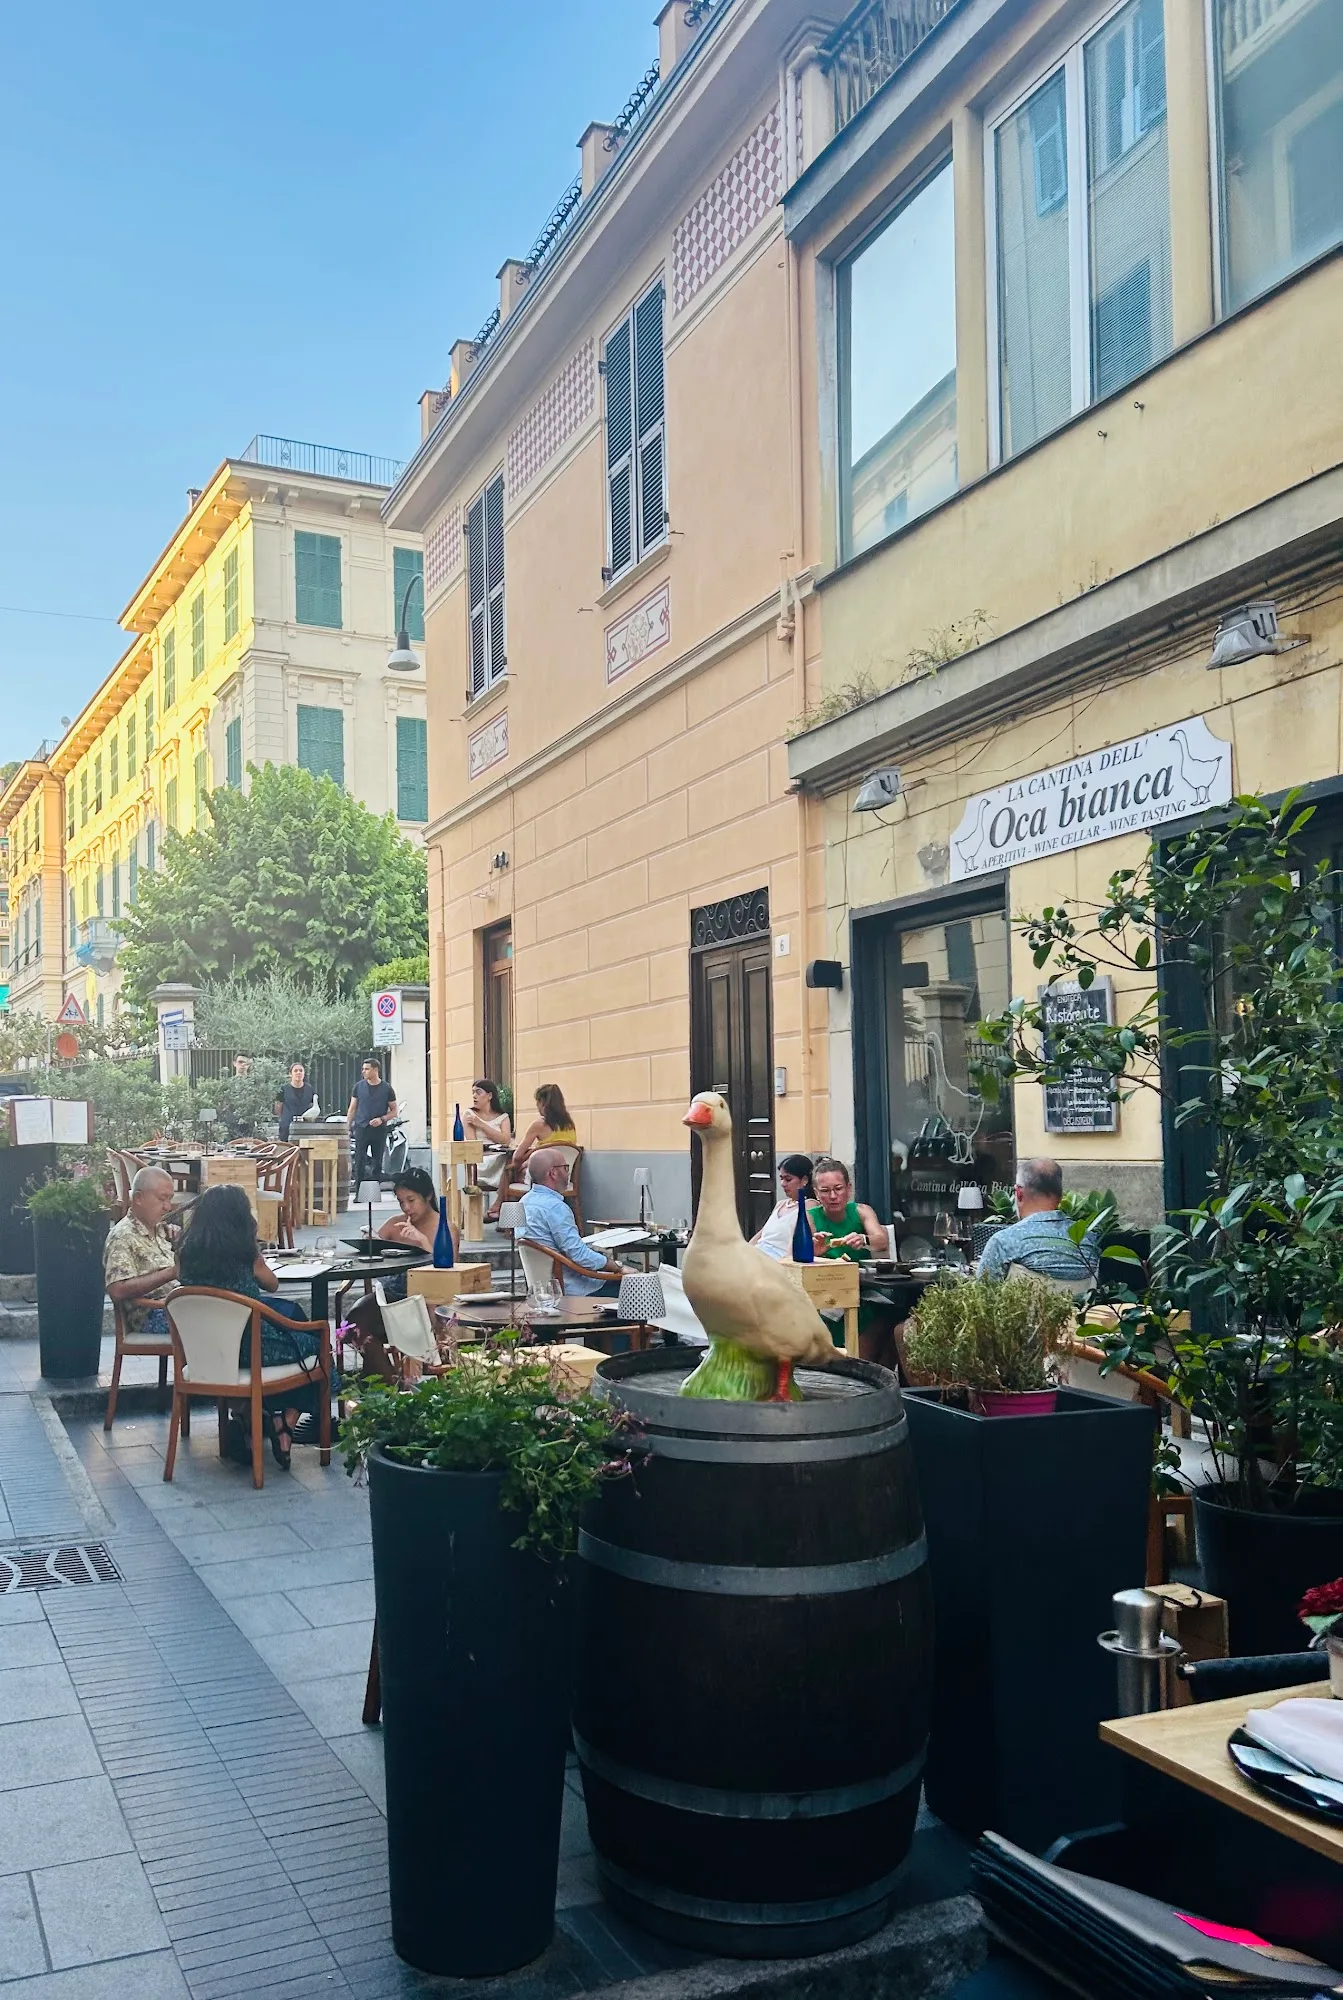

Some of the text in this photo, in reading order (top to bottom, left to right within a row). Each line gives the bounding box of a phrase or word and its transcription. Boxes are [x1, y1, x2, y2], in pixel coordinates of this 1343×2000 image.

[1007, 784, 1025, 803] LA
[1028, 759, 1093, 795] CANTINA
[989, 764, 1174, 849] Oca bianca
[980, 847, 1027, 869] APERITIVI
[1034, 837, 1059, 854] WINE
[1060, 824, 1100, 847] CELLAR
[1110, 816, 1138, 832] WINE
[1141, 799, 1187, 821] TASTING
[1057, 993, 1081, 1004] ENOTECA
[910, 1179, 946, 1193] Cantina
